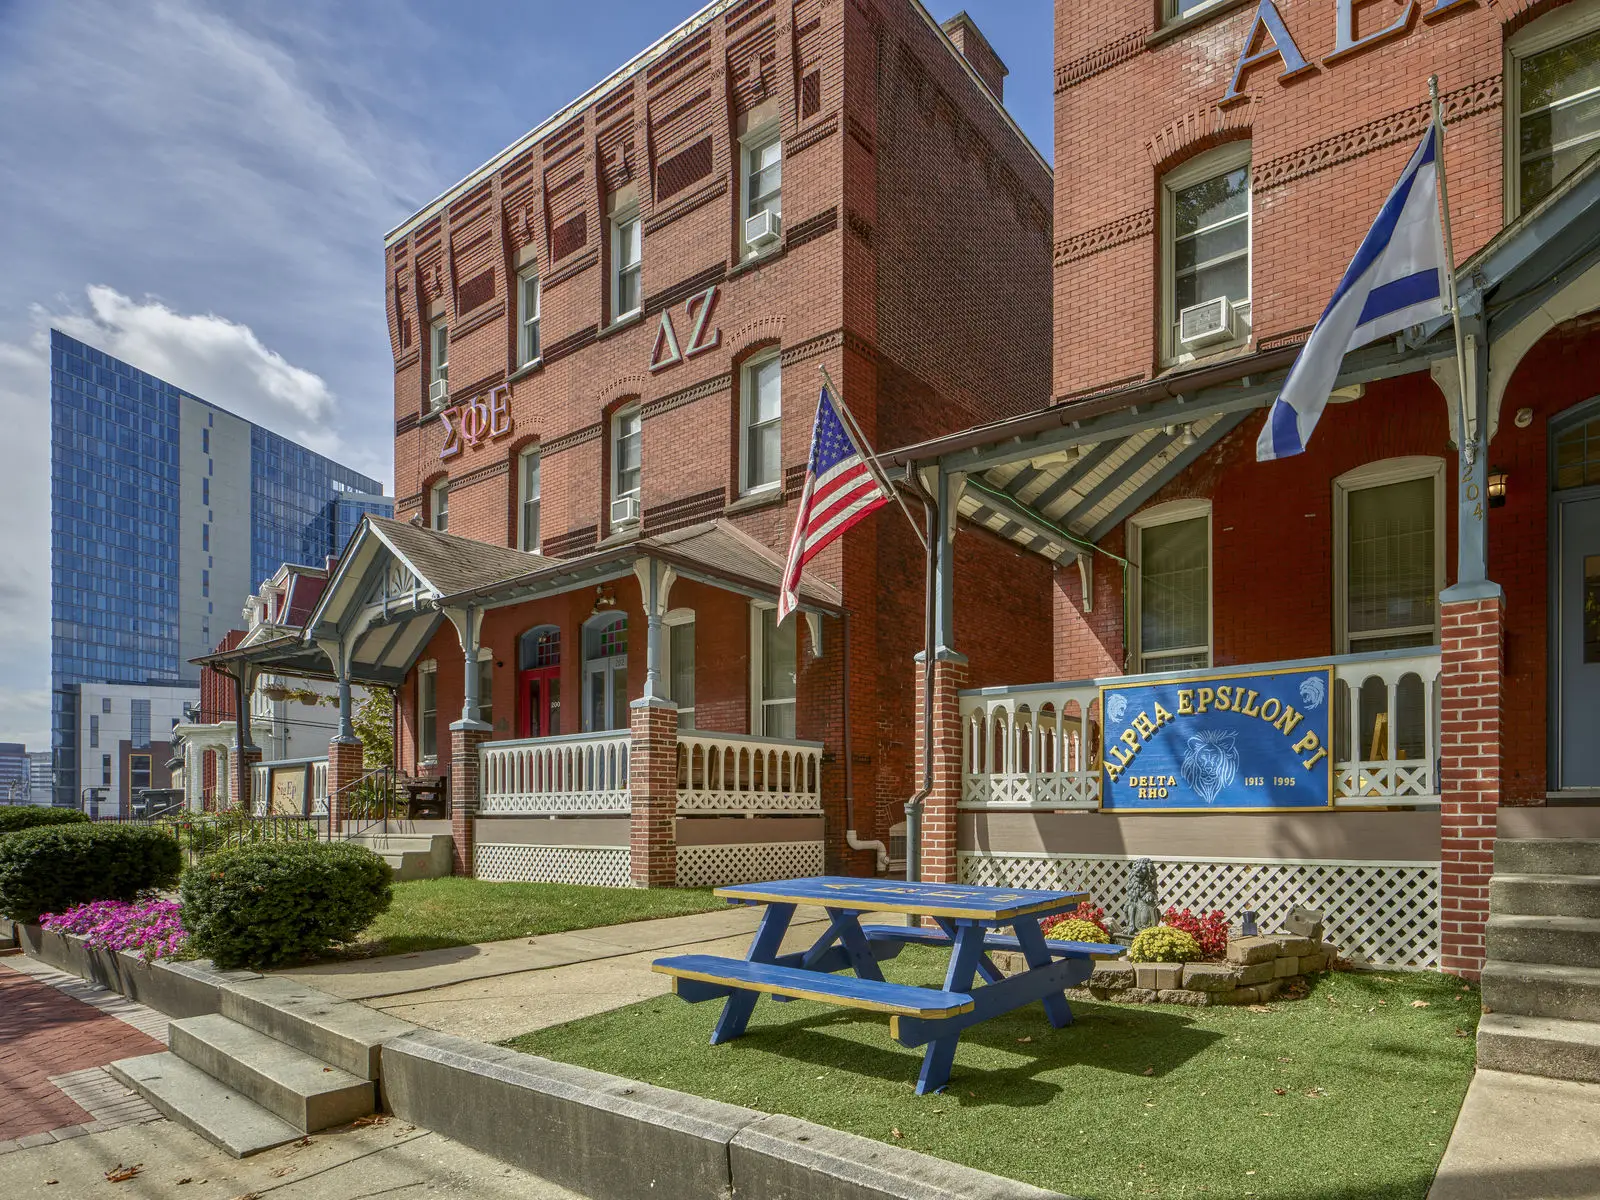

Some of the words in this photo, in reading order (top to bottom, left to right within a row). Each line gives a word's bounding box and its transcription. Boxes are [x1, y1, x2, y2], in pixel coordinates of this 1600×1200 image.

[1462, 465, 1483, 521] 204
[1103, 701, 1176, 782] ALPHA
[1177, 685, 1304, 736] EPSILON
[1292, 730, 1328, 770] PI
[1129, 775, 1177, 788] DELTA
[1245, 777, 1265, 786] 1913
[1273, 776, 1296, 786] 1995
[1138, 787, 1168, 799] RHO
